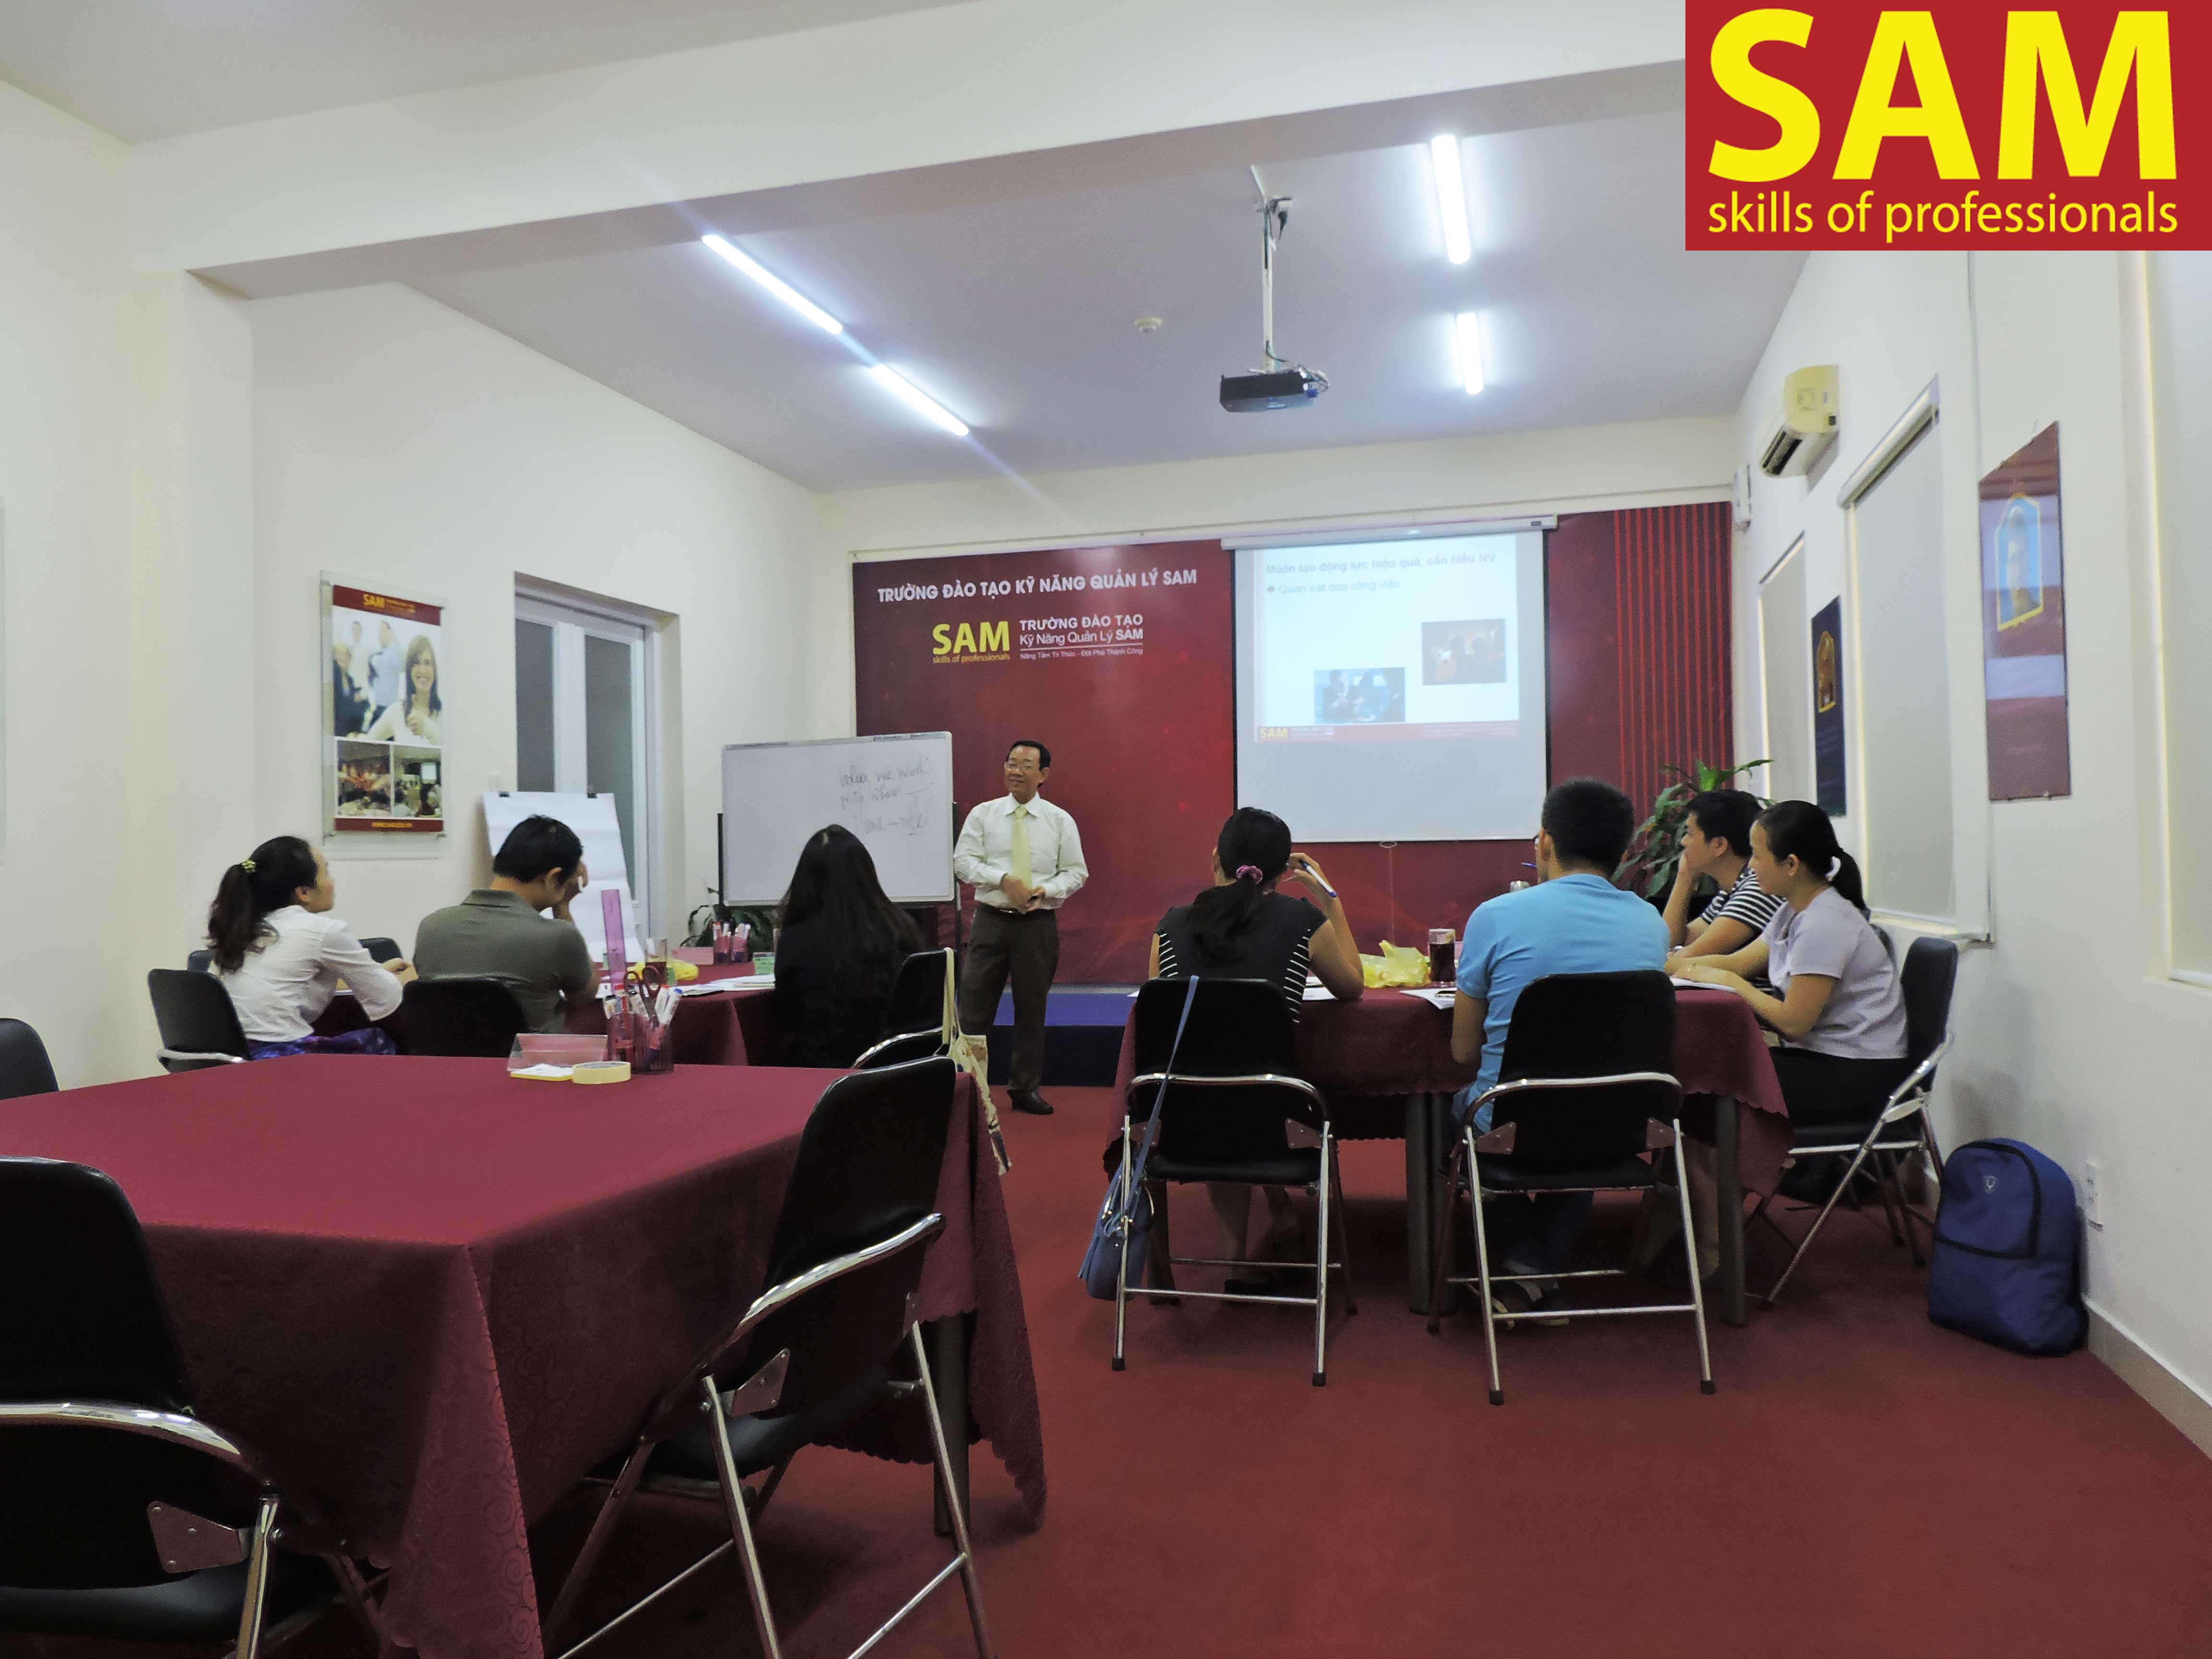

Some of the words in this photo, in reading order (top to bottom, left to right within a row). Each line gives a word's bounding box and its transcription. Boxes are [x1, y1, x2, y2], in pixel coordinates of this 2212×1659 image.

[1479, 553, 1496, 563] NV
[878, 582, 938, 602] TRƯỜNG
[941, 579, 976, 599] ĐÀO
[980, 580, 1011, 600] TẠO
[1015, 576, 1035, 594] KỸ
[1039, 574, 1086, 593] NĂNG
[1090, 568, 1137, 590] QUẢN
[1141, 567, 1158, 587] LÝ
[1163, 569, 1197, 586] SAM
[1019, 616, 1078, 631] TRƯỜNG
[1082, 614, 1111, 628] ĐÀO
[1114, 614, 1143, 628] TẠO
[932, 620, 1010, 655] SAM
[1020, 634, 1034, 648] Kỹ
[1036, 633, 1065, 646] Năng
[1067, 631, 1097, 643] Quản
[1099, 630, 1113, 643] Lý
[1115, 628, 1143, 641] SAM
[1260, 727, 1288, 738] SAM
